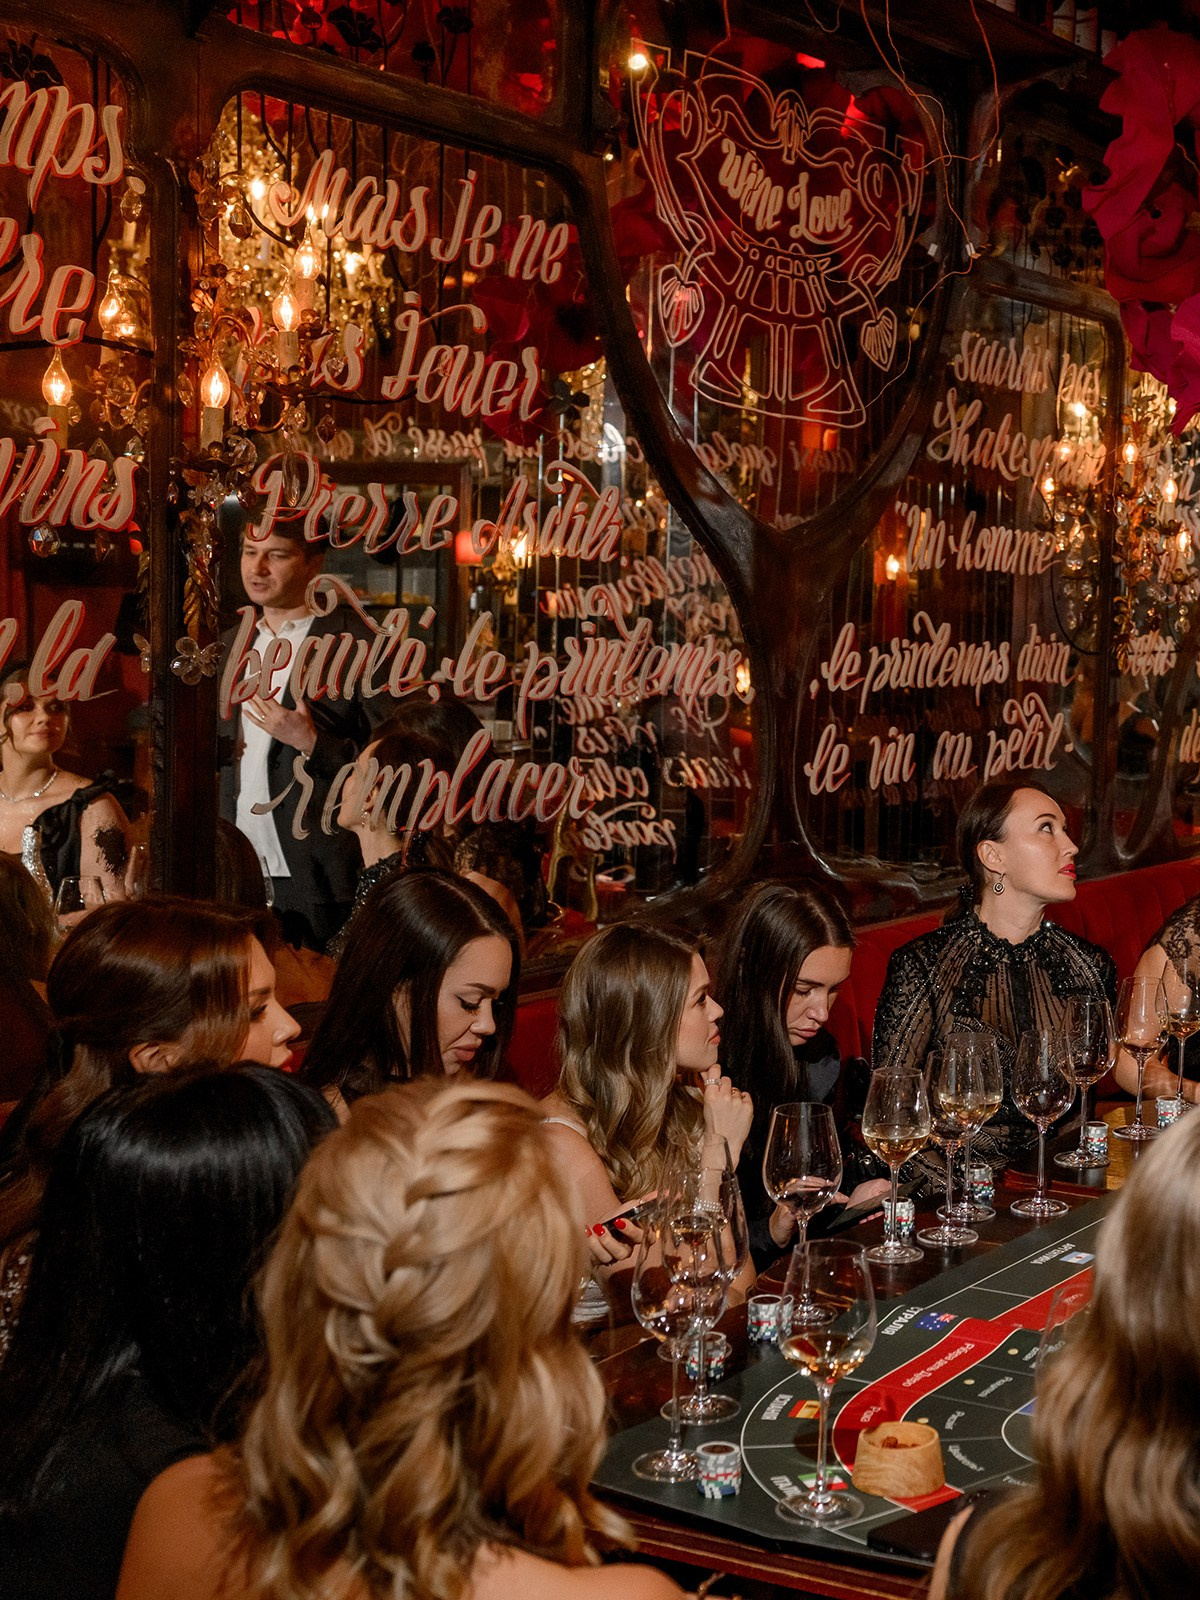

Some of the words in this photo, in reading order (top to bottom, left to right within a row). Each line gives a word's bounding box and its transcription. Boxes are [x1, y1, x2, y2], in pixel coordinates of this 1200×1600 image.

[718, 138, 785, 231] Wine
[788, 172, 854, 245] Love
[508, 214, 569, 284] ne
